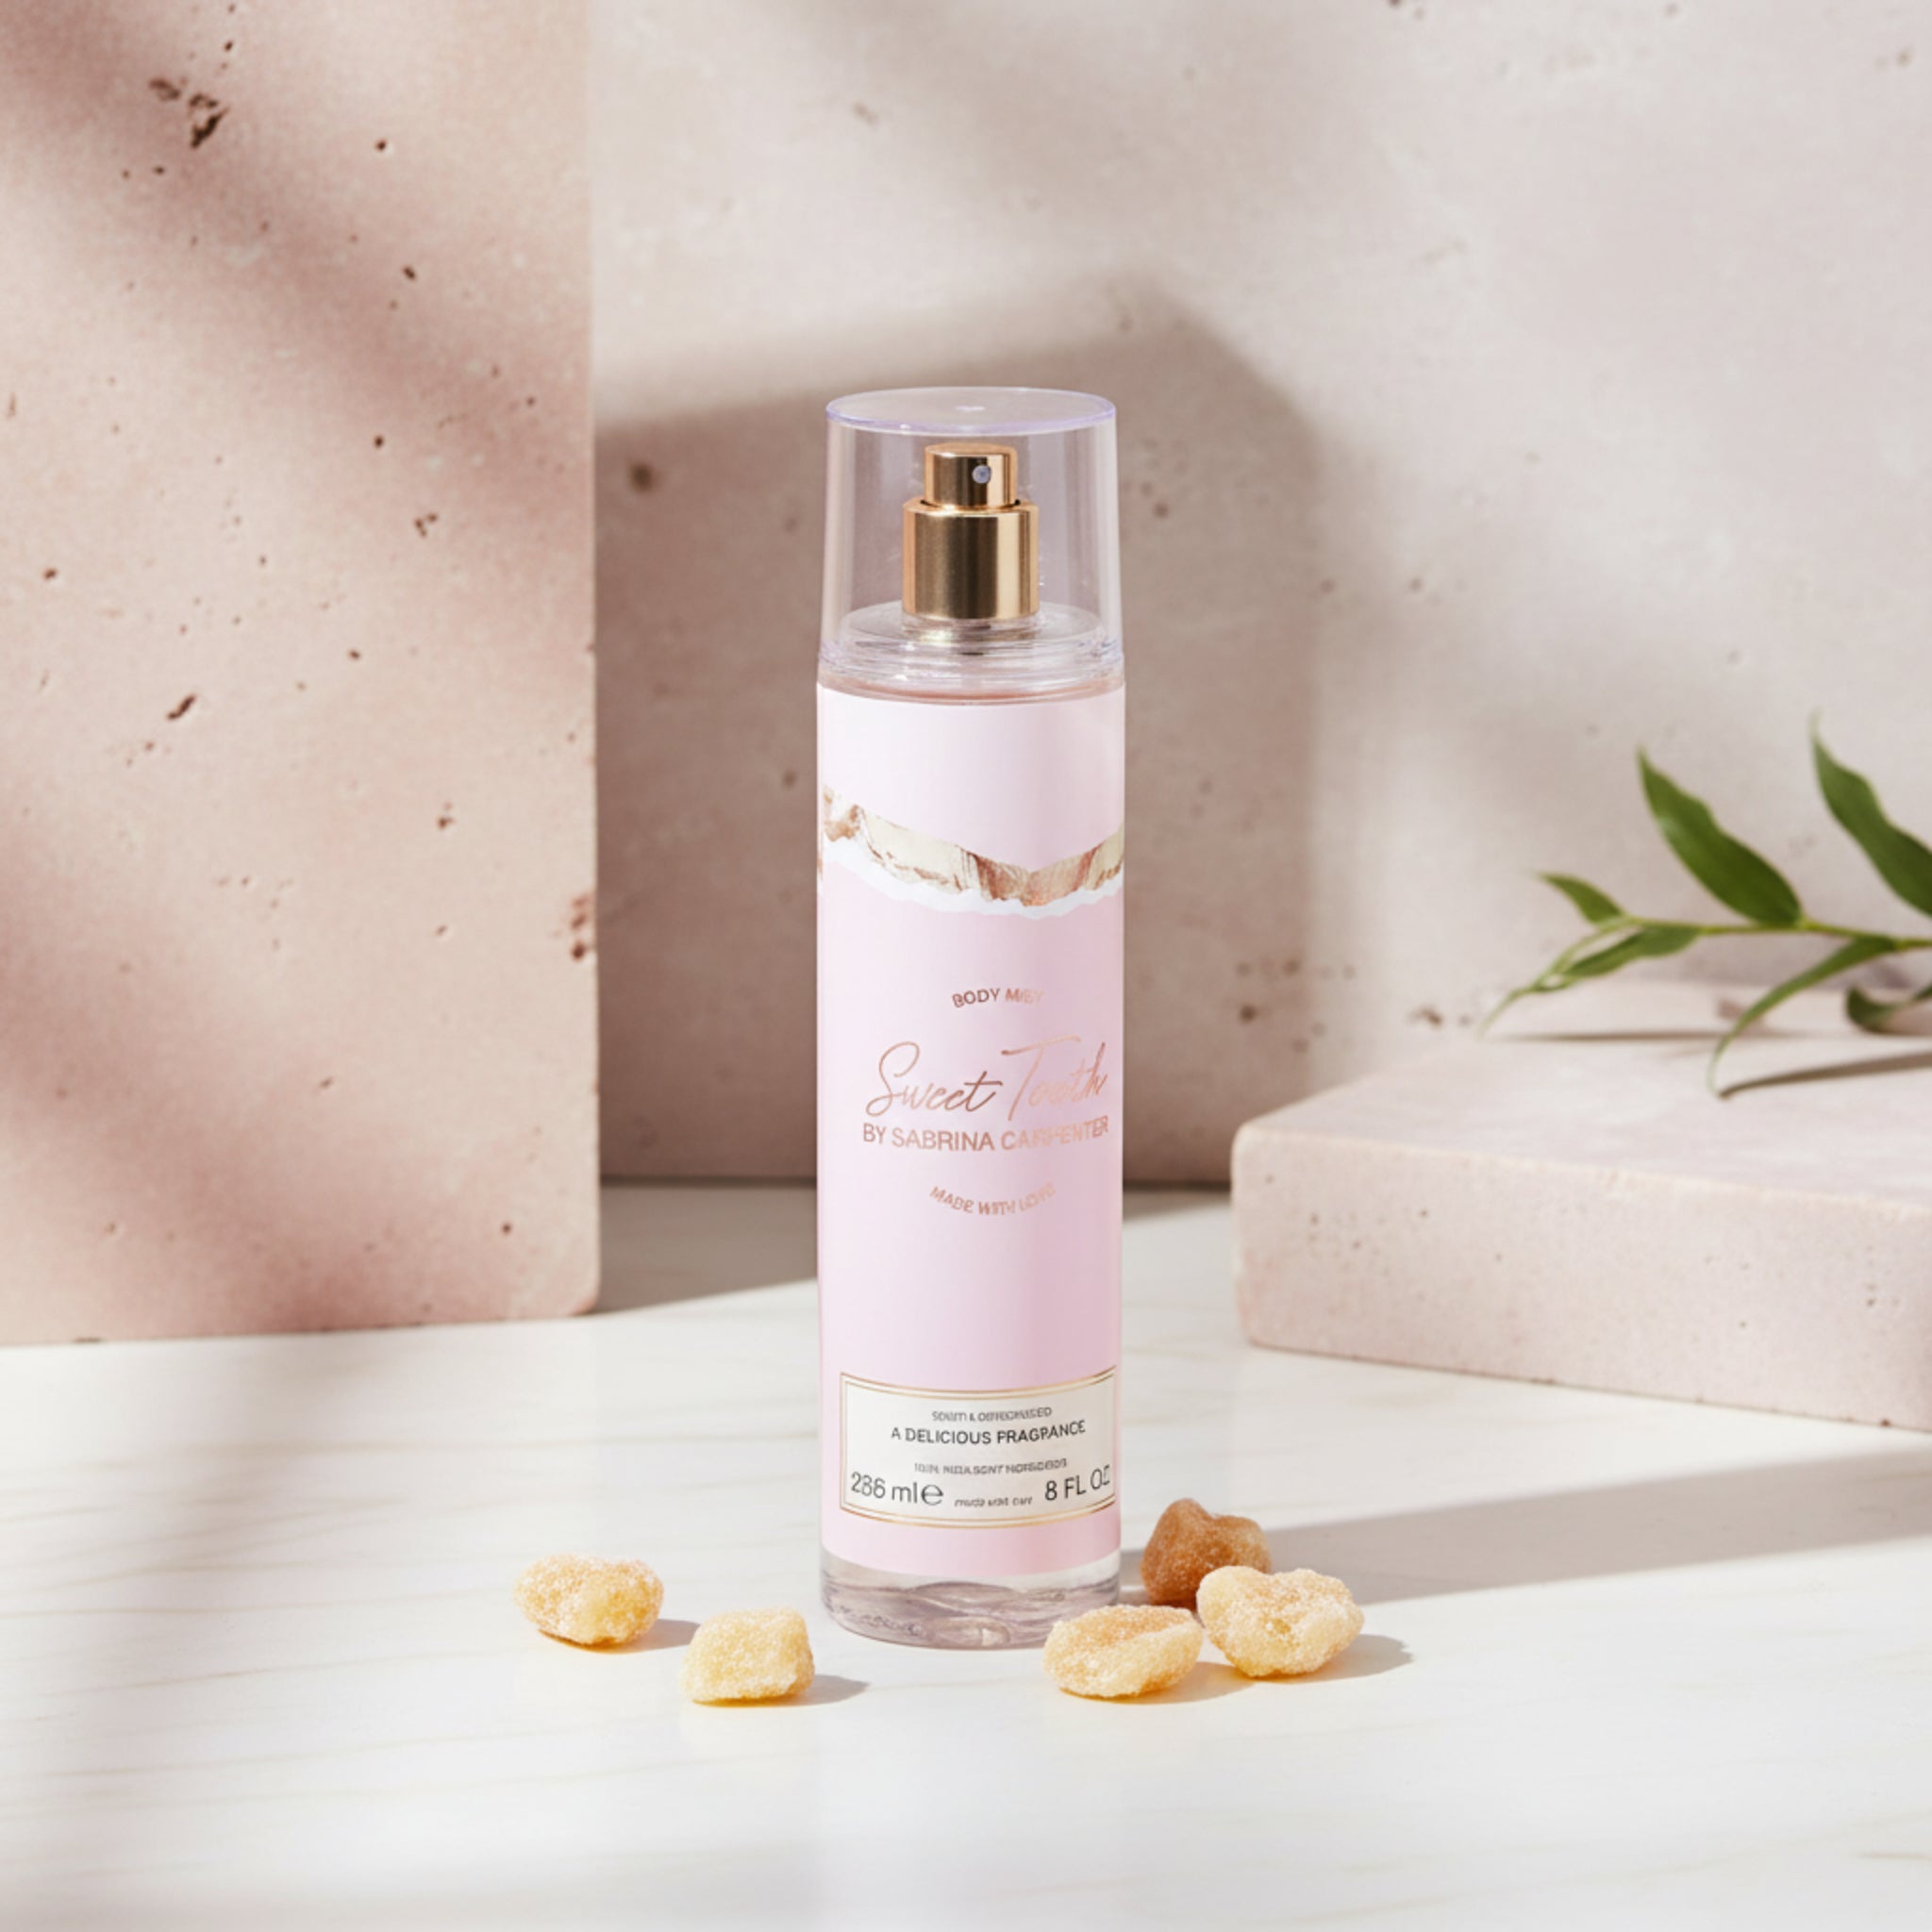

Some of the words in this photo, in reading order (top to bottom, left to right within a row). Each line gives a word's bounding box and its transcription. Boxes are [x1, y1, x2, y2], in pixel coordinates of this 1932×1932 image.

[952, 988, 1001, 1008] BODY
[866, 1041, 1004, 1117] Sweet
[863, 1123, 887, 1144] BY
[891, 1127, 995, 1152] SABRINA
[929, 1186, 974, 1214] MADE
[891, 1427, 901, 1440] A
[905, 1427, 991, 1444] DELICIOUS
[1044, 1480, 1058, 1502] 8
[1064, 1474, 1087, 1499] FL
